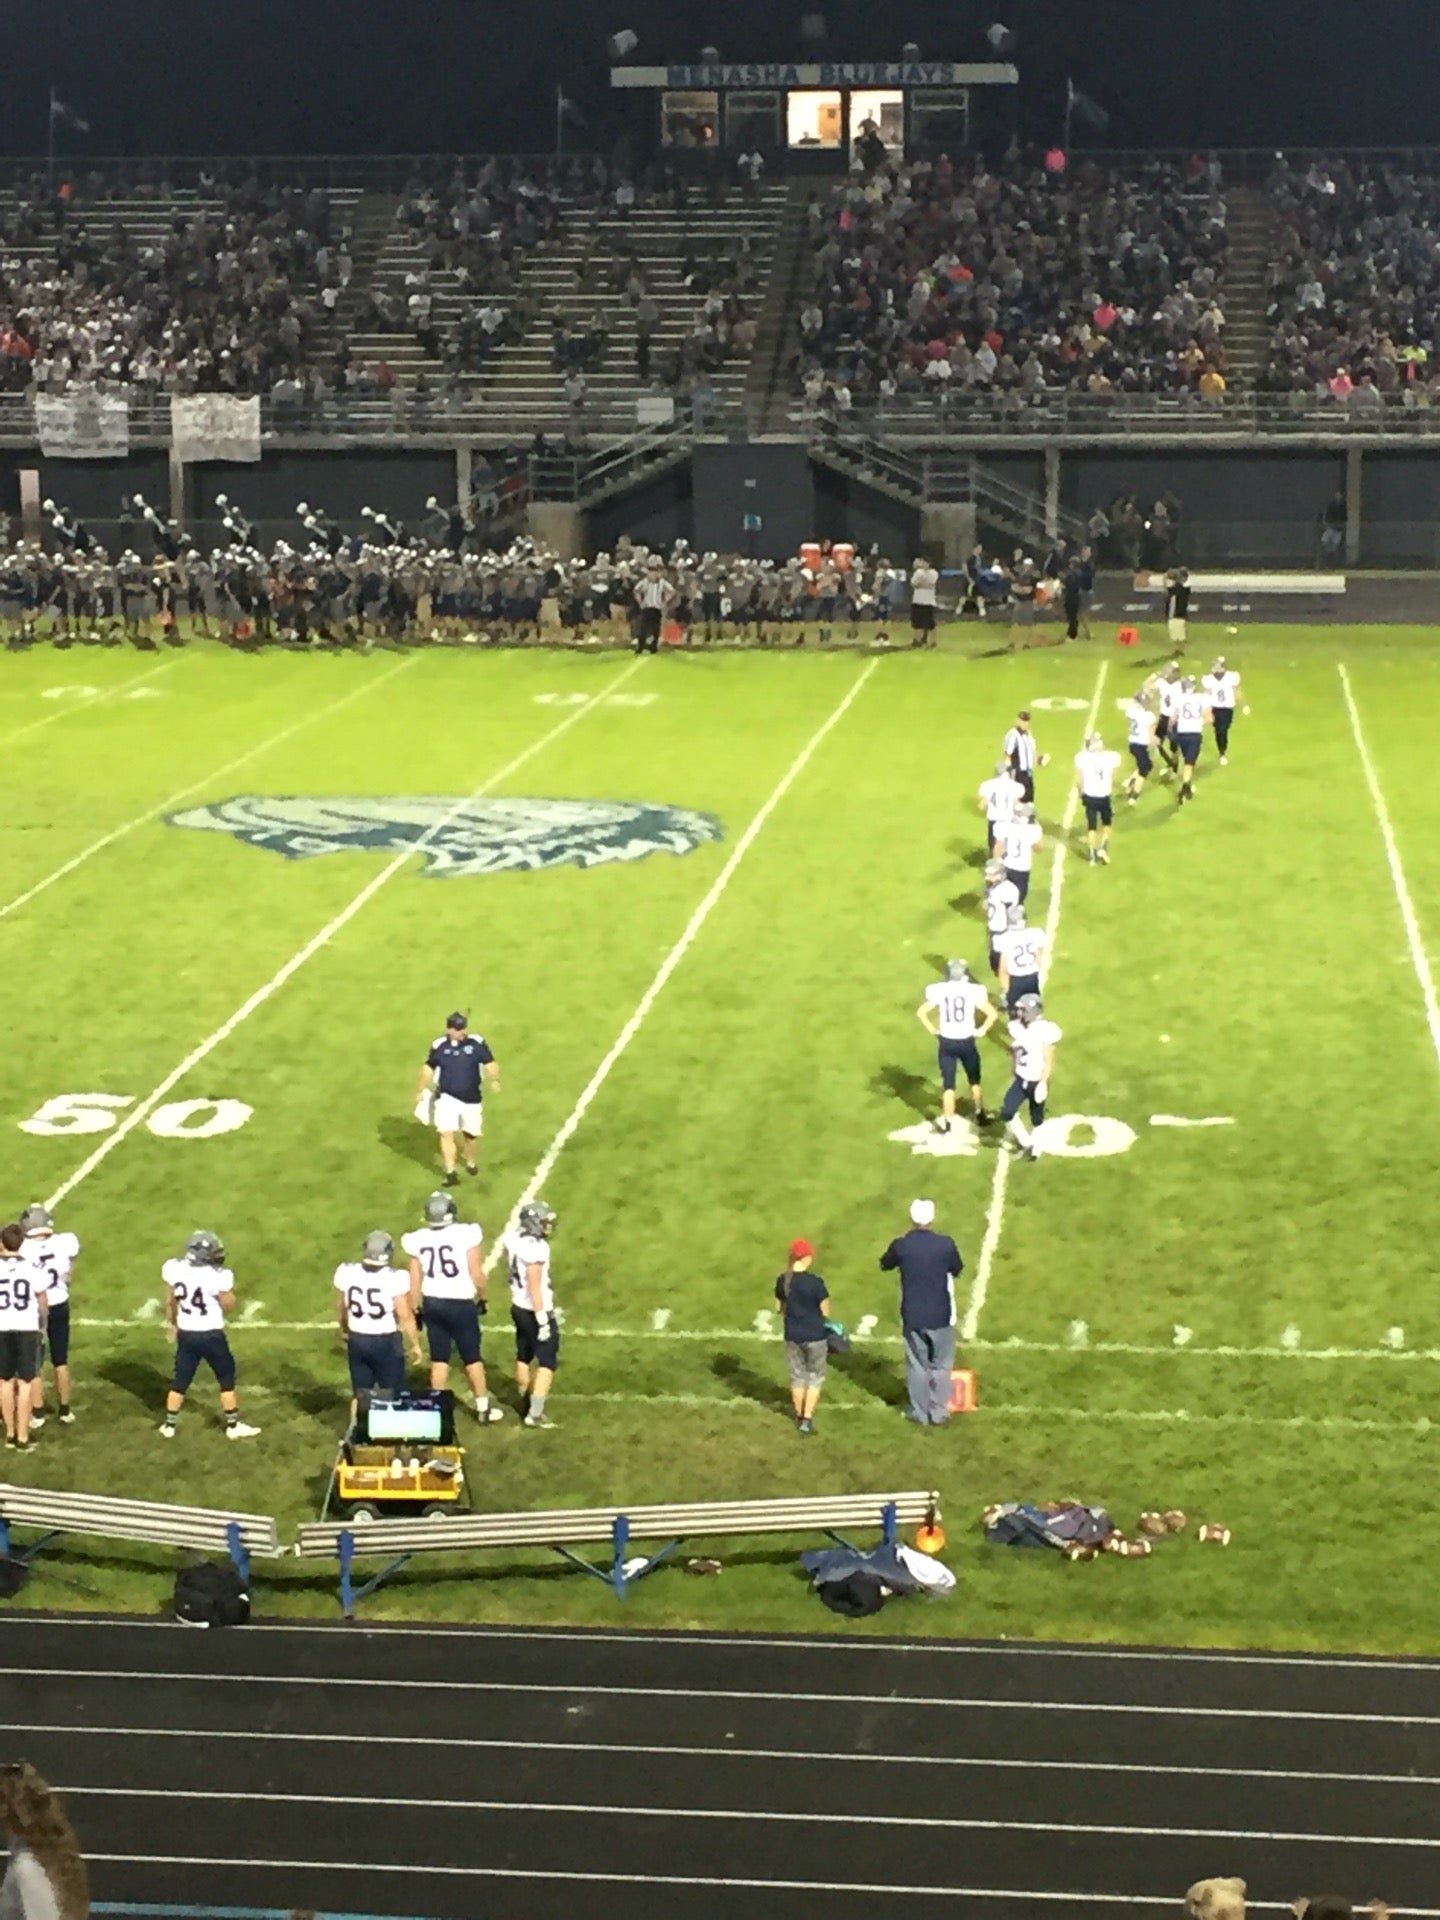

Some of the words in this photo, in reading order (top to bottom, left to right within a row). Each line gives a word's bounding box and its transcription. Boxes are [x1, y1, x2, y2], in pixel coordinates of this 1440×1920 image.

[1014, 942, 1037, 968] 25
[944, 995, 966, 1024] 18
[18, 1092, 254, 1138] 50
[421, 1245, 460, 1278] 76
[173, 1282, 208, 1316] 24
[348, 1286, 386, 1320] 65
